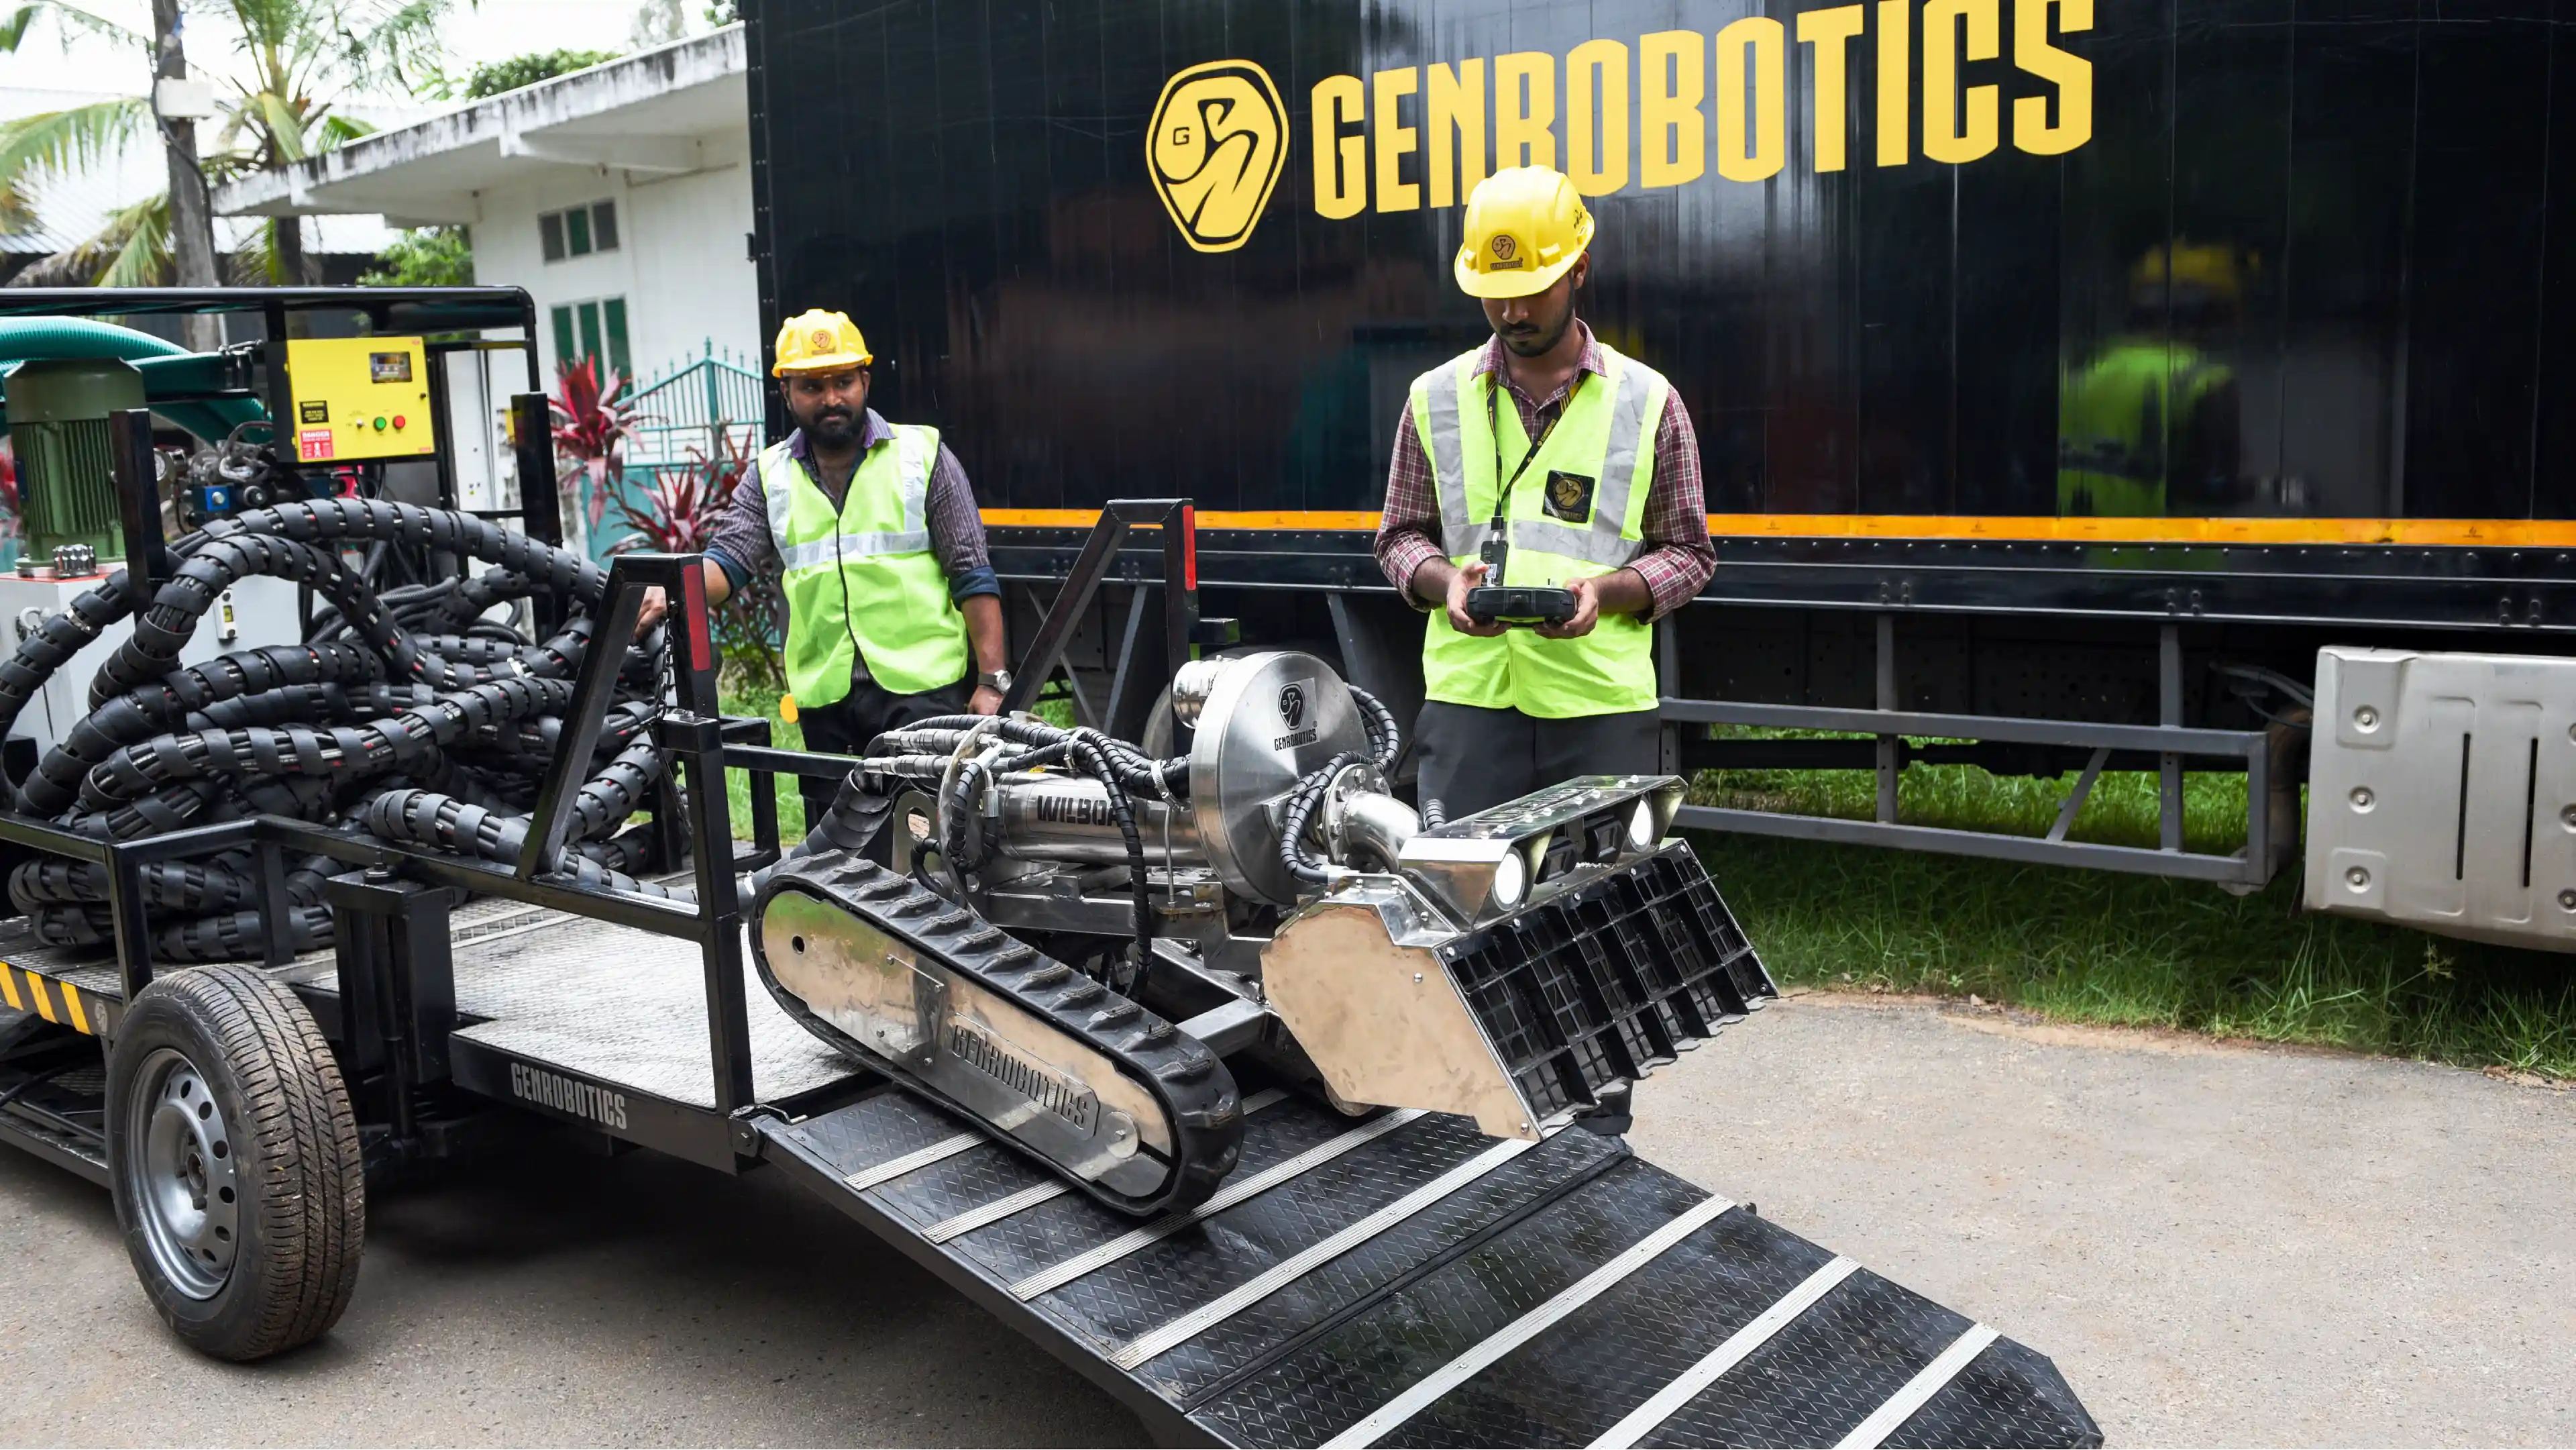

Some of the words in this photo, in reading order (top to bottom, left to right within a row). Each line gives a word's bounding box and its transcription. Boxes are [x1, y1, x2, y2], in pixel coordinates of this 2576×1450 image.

[1312, 0, 2093, 220] GENROBOTICS
[1275, 729, 1317, 751] GENROBOTICS
[1037, 795, 1136, 827] WILBOA
[511, 1062, 627, 1130] GENROBOTICS
[953, 1025, 1089, 1131] GENROBOTICS
